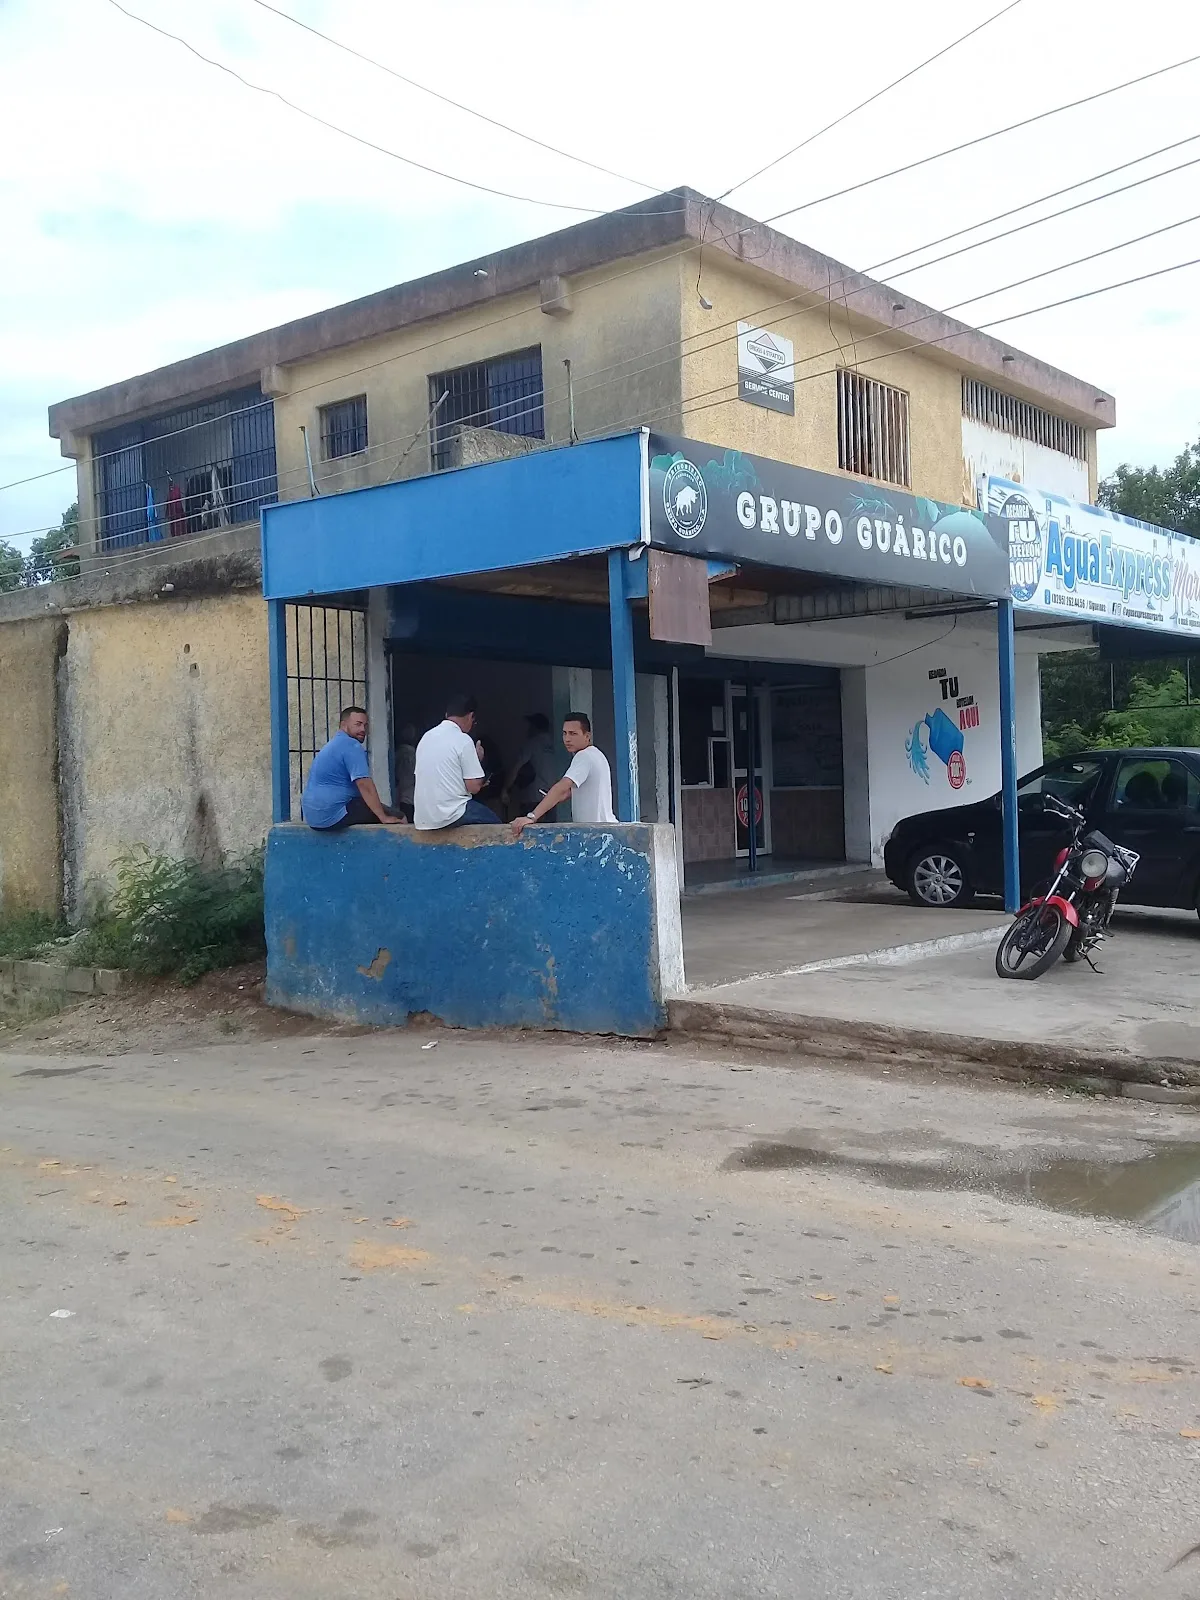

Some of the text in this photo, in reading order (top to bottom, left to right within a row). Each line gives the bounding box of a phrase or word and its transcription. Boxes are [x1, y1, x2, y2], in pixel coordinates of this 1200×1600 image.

[744, 381, 768, 395] SERVICE
[768, 389, 790, 402] CENTER
[1005, 504, 1030, 518] RECARGA
[736, 491, 967, 566] GRUPO GUÁRICO
[1009, 520, 1037, 542] TU
[1010, 559, 1039, 586] AQUÍ
[939, 677, 959, 700] TU
